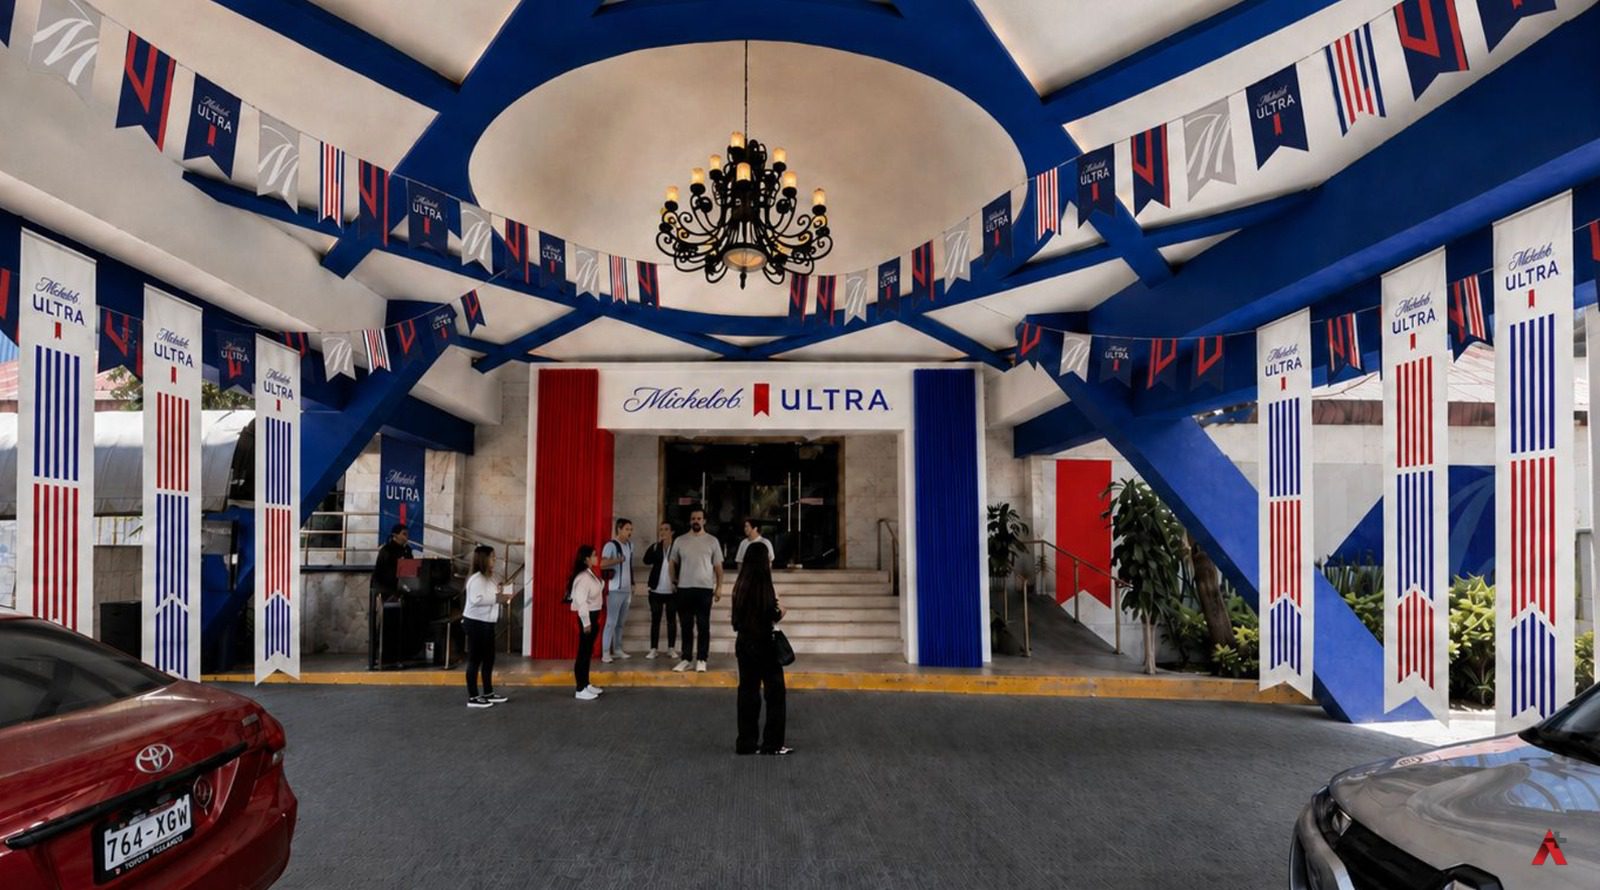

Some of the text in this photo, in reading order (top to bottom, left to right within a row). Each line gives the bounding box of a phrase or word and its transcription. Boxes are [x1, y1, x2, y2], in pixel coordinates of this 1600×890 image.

[197, 104, 232, 133] ULTRA
[1256, 94, 1296, 119] ULTRA
[1080, 167, 1110, 185] ULTRA
[412, 203, 443, 221] ULTRA
[1505, 260, 1559, 291] ULTRA
[33, 294, 85, 326] ULTRA
[1392, 307, 1436, 334] ULTRA
[153, 342, 194, 369] ULTRA
[1265, 356, 1302, 377] ULTRA
[263, 380, 294, 400] ULTRA
[623, 386, 889, 413] Michelob ULTRA
[386, 485, 420, 502] ULTRA
[107, 804, 188, 863] 764-XGW
